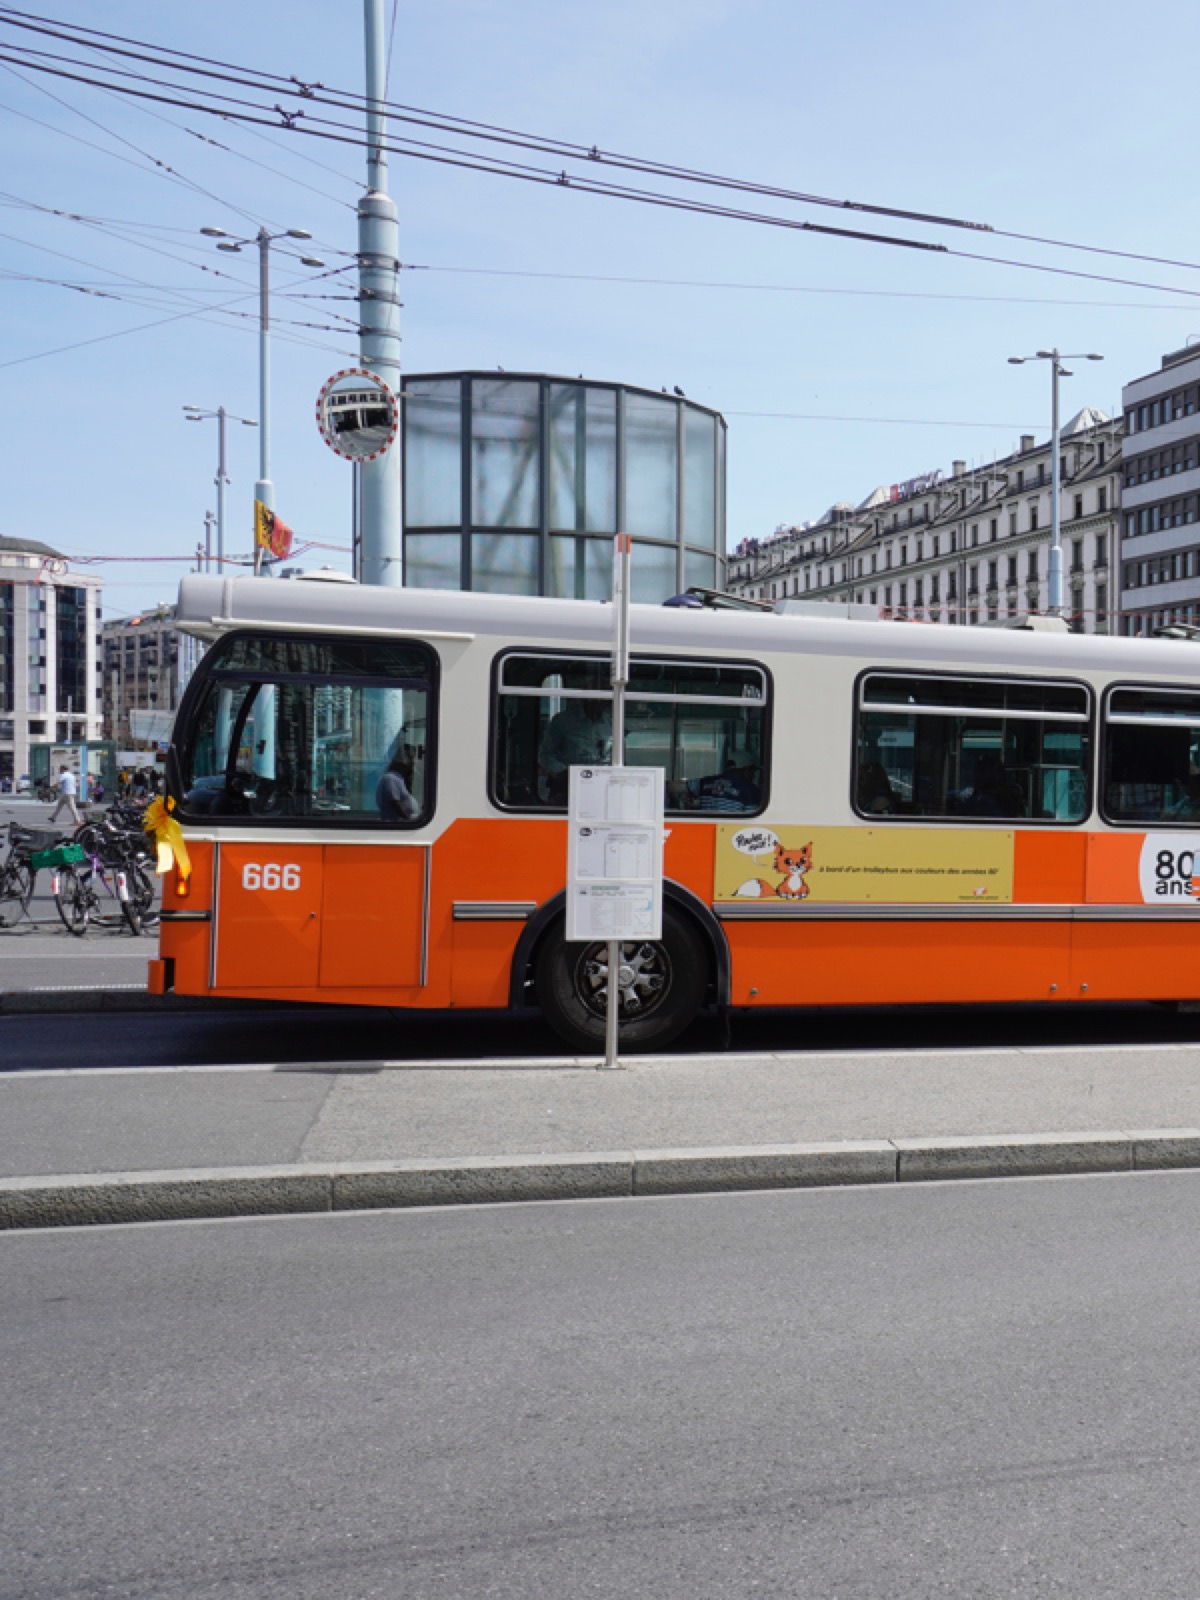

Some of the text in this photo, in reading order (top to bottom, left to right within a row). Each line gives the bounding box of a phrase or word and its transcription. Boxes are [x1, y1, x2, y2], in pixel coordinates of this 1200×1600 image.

[242, 862, 301, 891] 666
[1155, 849, 1194, 879] 80
[1155, 879, 1193, 895] ans
